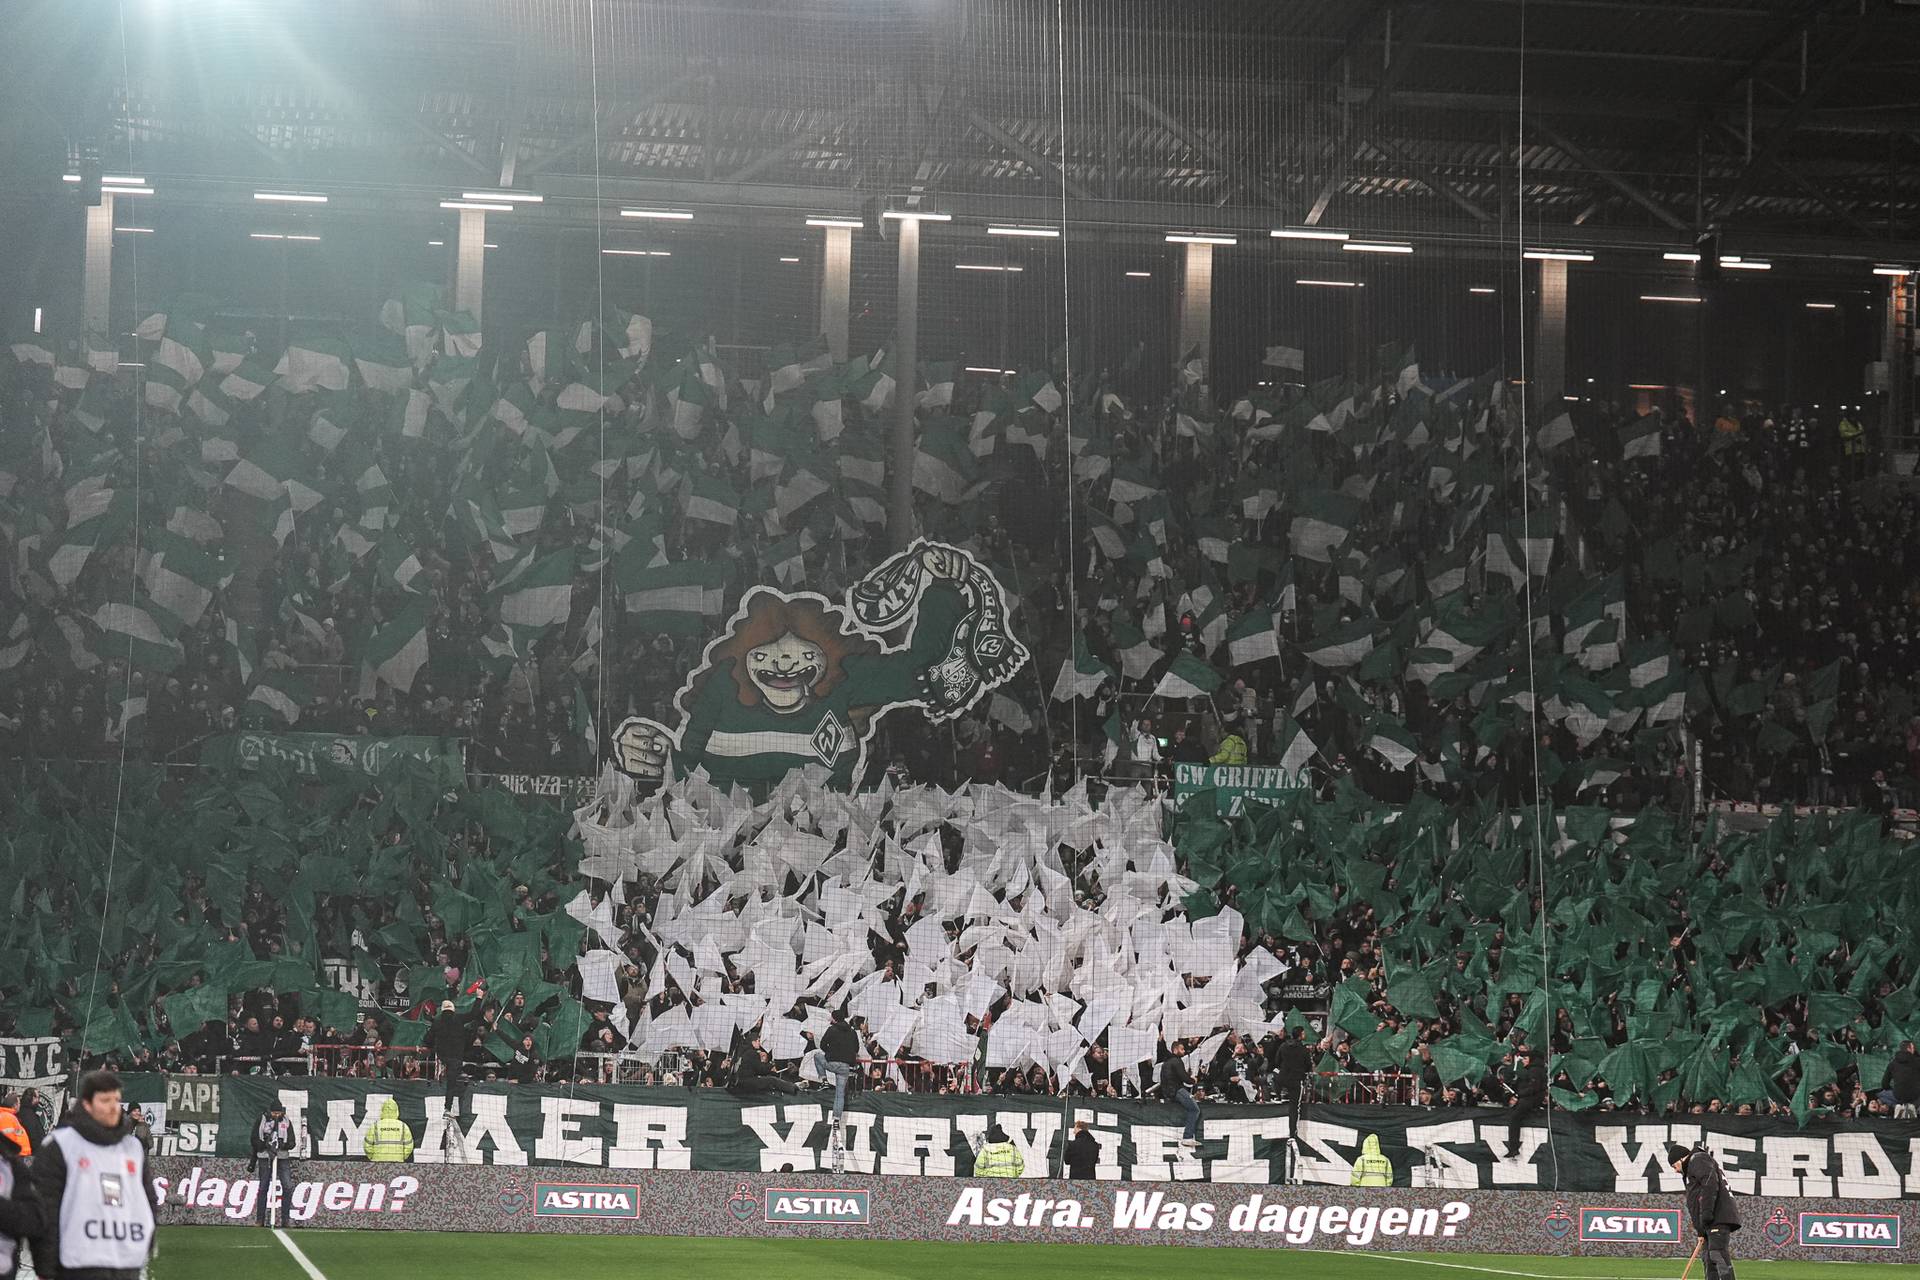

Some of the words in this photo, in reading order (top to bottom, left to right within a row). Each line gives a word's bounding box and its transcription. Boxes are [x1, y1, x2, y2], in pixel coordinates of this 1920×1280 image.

[1175, 764, 1207, 786] GW
[278, 1089, 691, 1169] IMMER
[1404, 1119, 1549, 1189] SV
[542, 1190, 631, 1210] ASTRA
[773, 1197, 861, 1216] ASTRA
[945, 1187, 1095, 1228] Astra.
[1112, 1190, 1216, 1231] Was
[1228, 1194, 1471, 1245] dagegen?
[1588, 1215, 1673, 1235] ASTRA
[84, 1220, 145, 1242] CLUB
[1808, 1221, 1892, 1240] ASTRA
